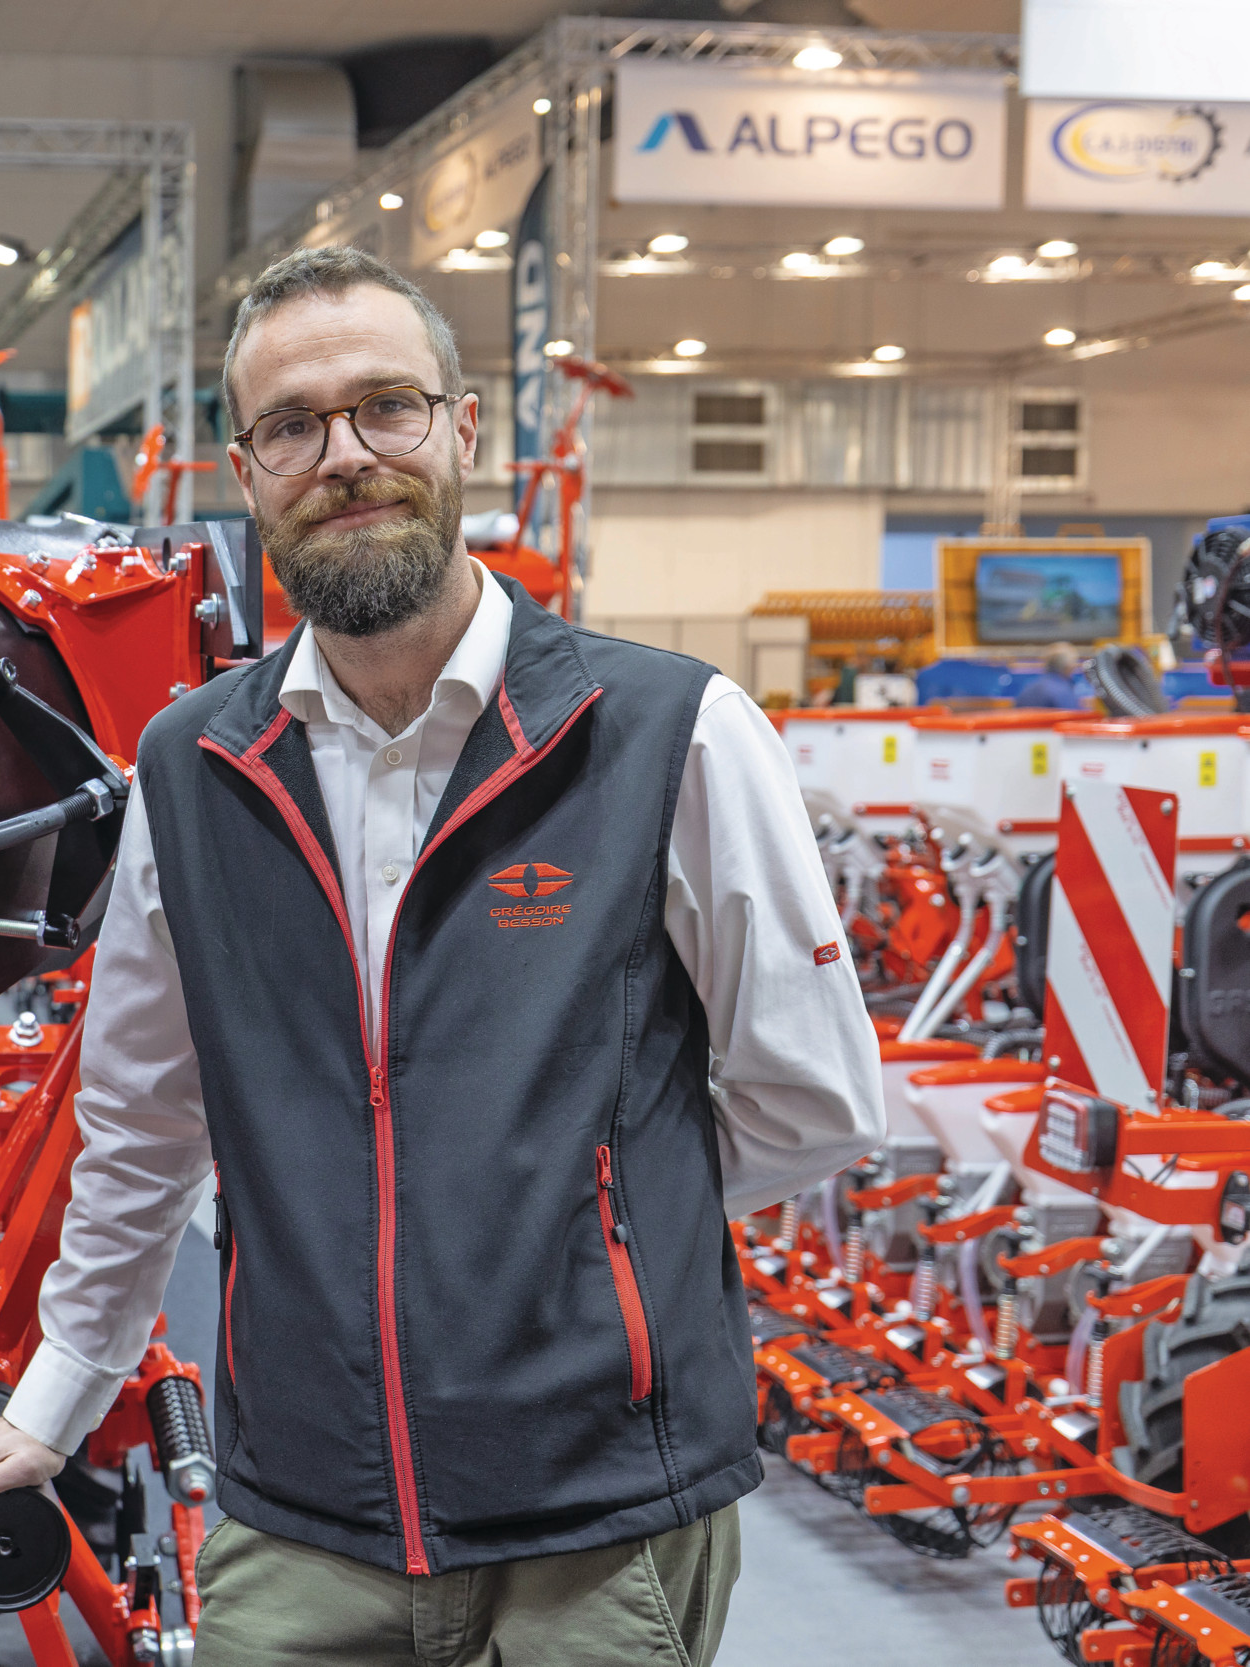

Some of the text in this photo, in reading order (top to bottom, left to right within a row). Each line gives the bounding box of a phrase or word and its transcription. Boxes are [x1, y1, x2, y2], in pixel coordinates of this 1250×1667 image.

[726, 114, 975, 161] ALPEGO
[490, 904, 572, 917] GRÉGOIRE
[498, 916, 564, 928] BESSON
